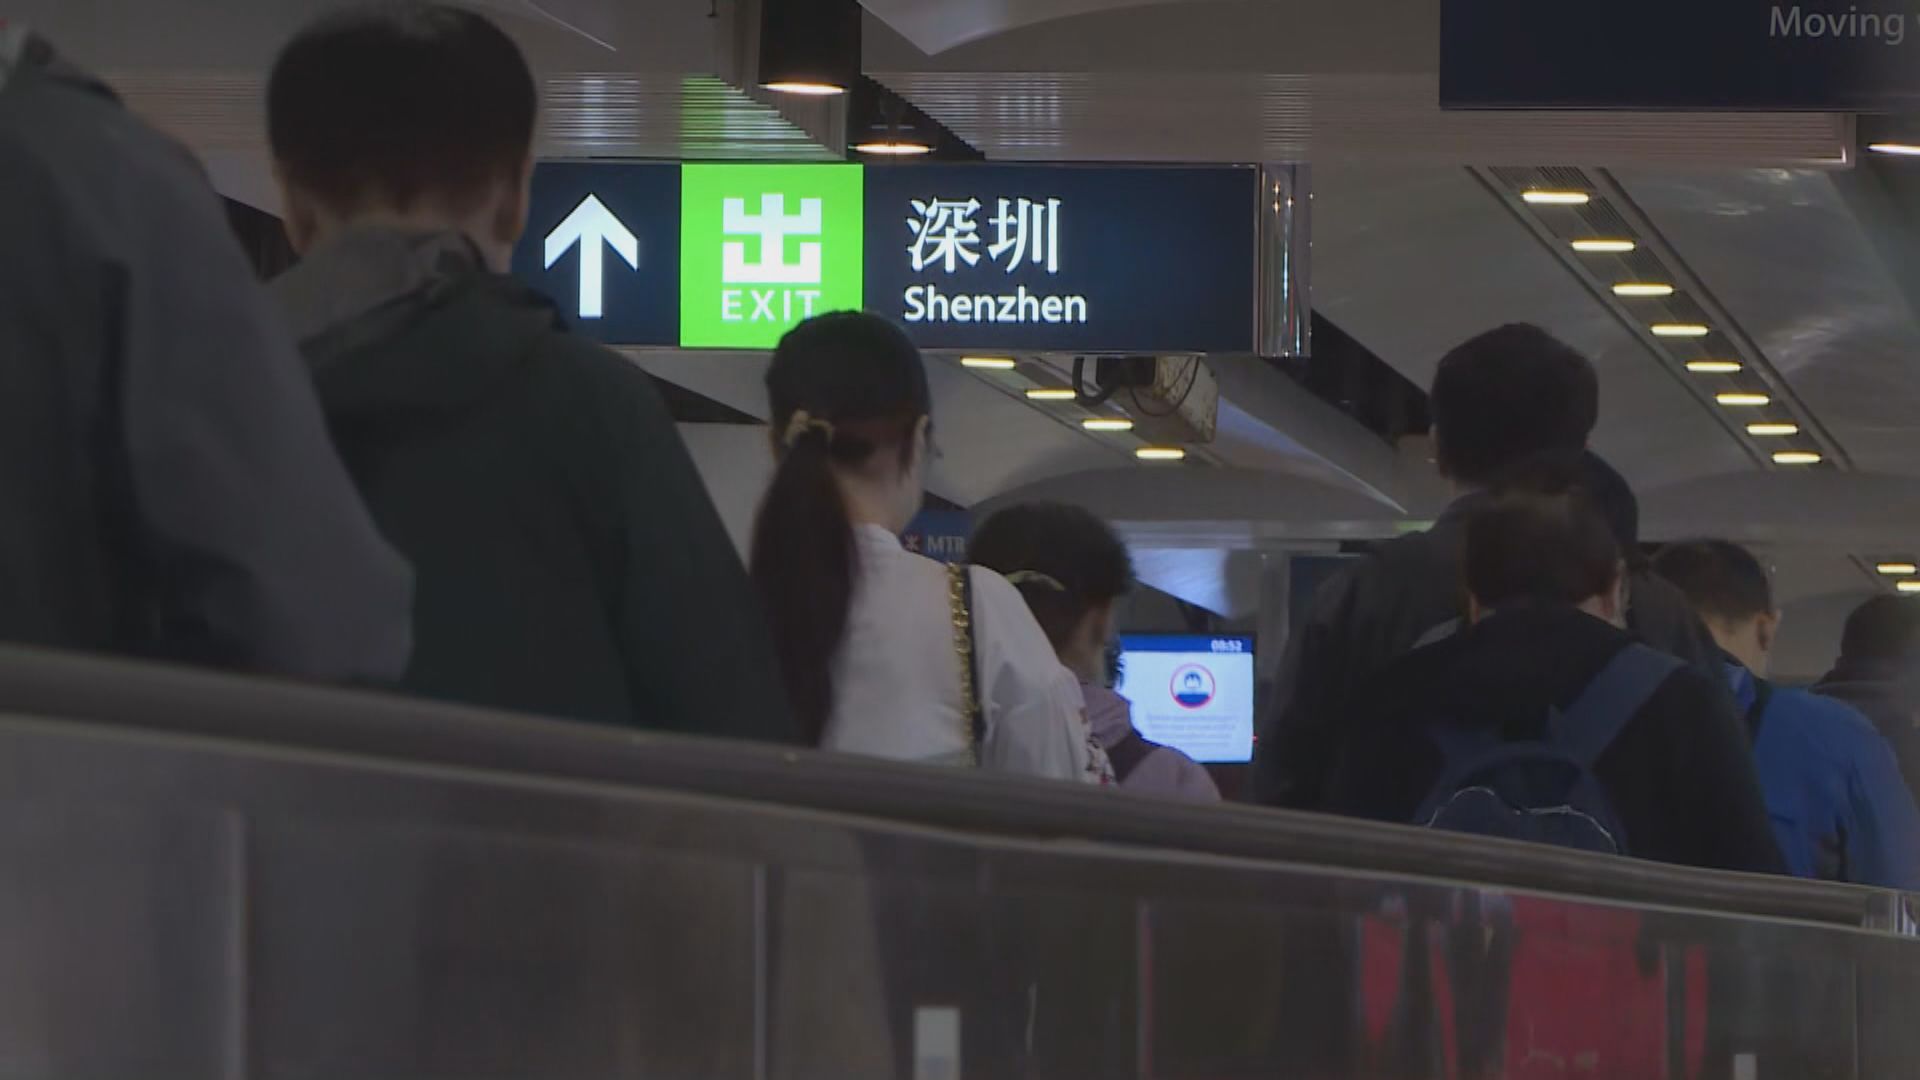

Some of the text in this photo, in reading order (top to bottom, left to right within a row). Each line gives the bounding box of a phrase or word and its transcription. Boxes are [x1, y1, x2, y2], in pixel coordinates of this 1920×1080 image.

[1769, 5, 1905, 46] Moving
[722, 193, 822, 283] 出
[906, 197, 1061, 274] 深圳
[722, 290, 821, 320] EXIT
[904, 285, 1087, 323] Shenzhen
[927, 534, 966, 553] MTR
